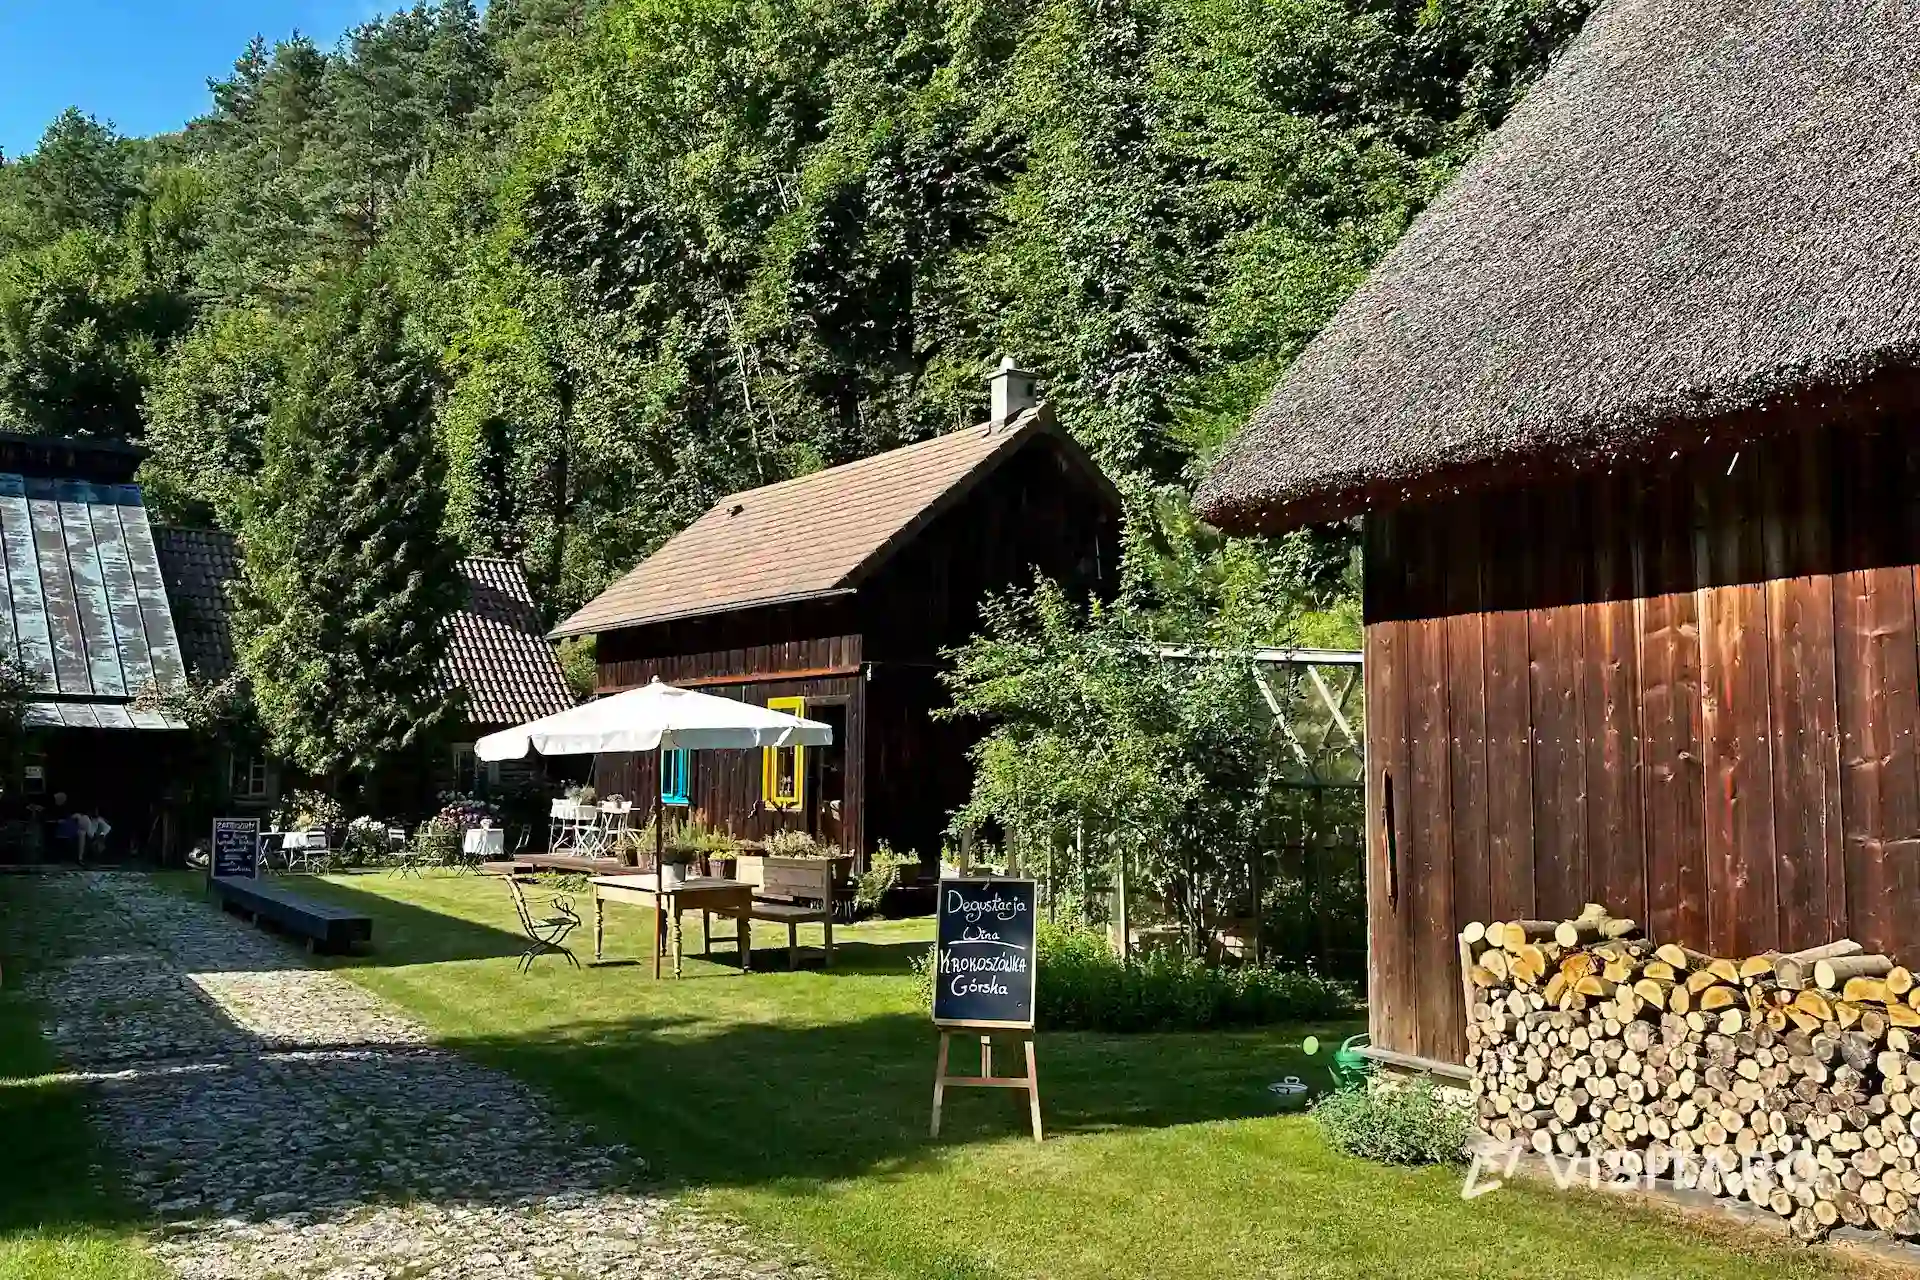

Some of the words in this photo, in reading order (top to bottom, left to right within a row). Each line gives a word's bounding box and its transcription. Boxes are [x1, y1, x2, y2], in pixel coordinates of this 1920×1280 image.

[947, 889, 1027, 922] Degustacja
[962, 926, 1000, 941] Wina
[940, 948, 1027, 974] KROKOSZÓWKA
[950, 975, 1009, 996] Górska
